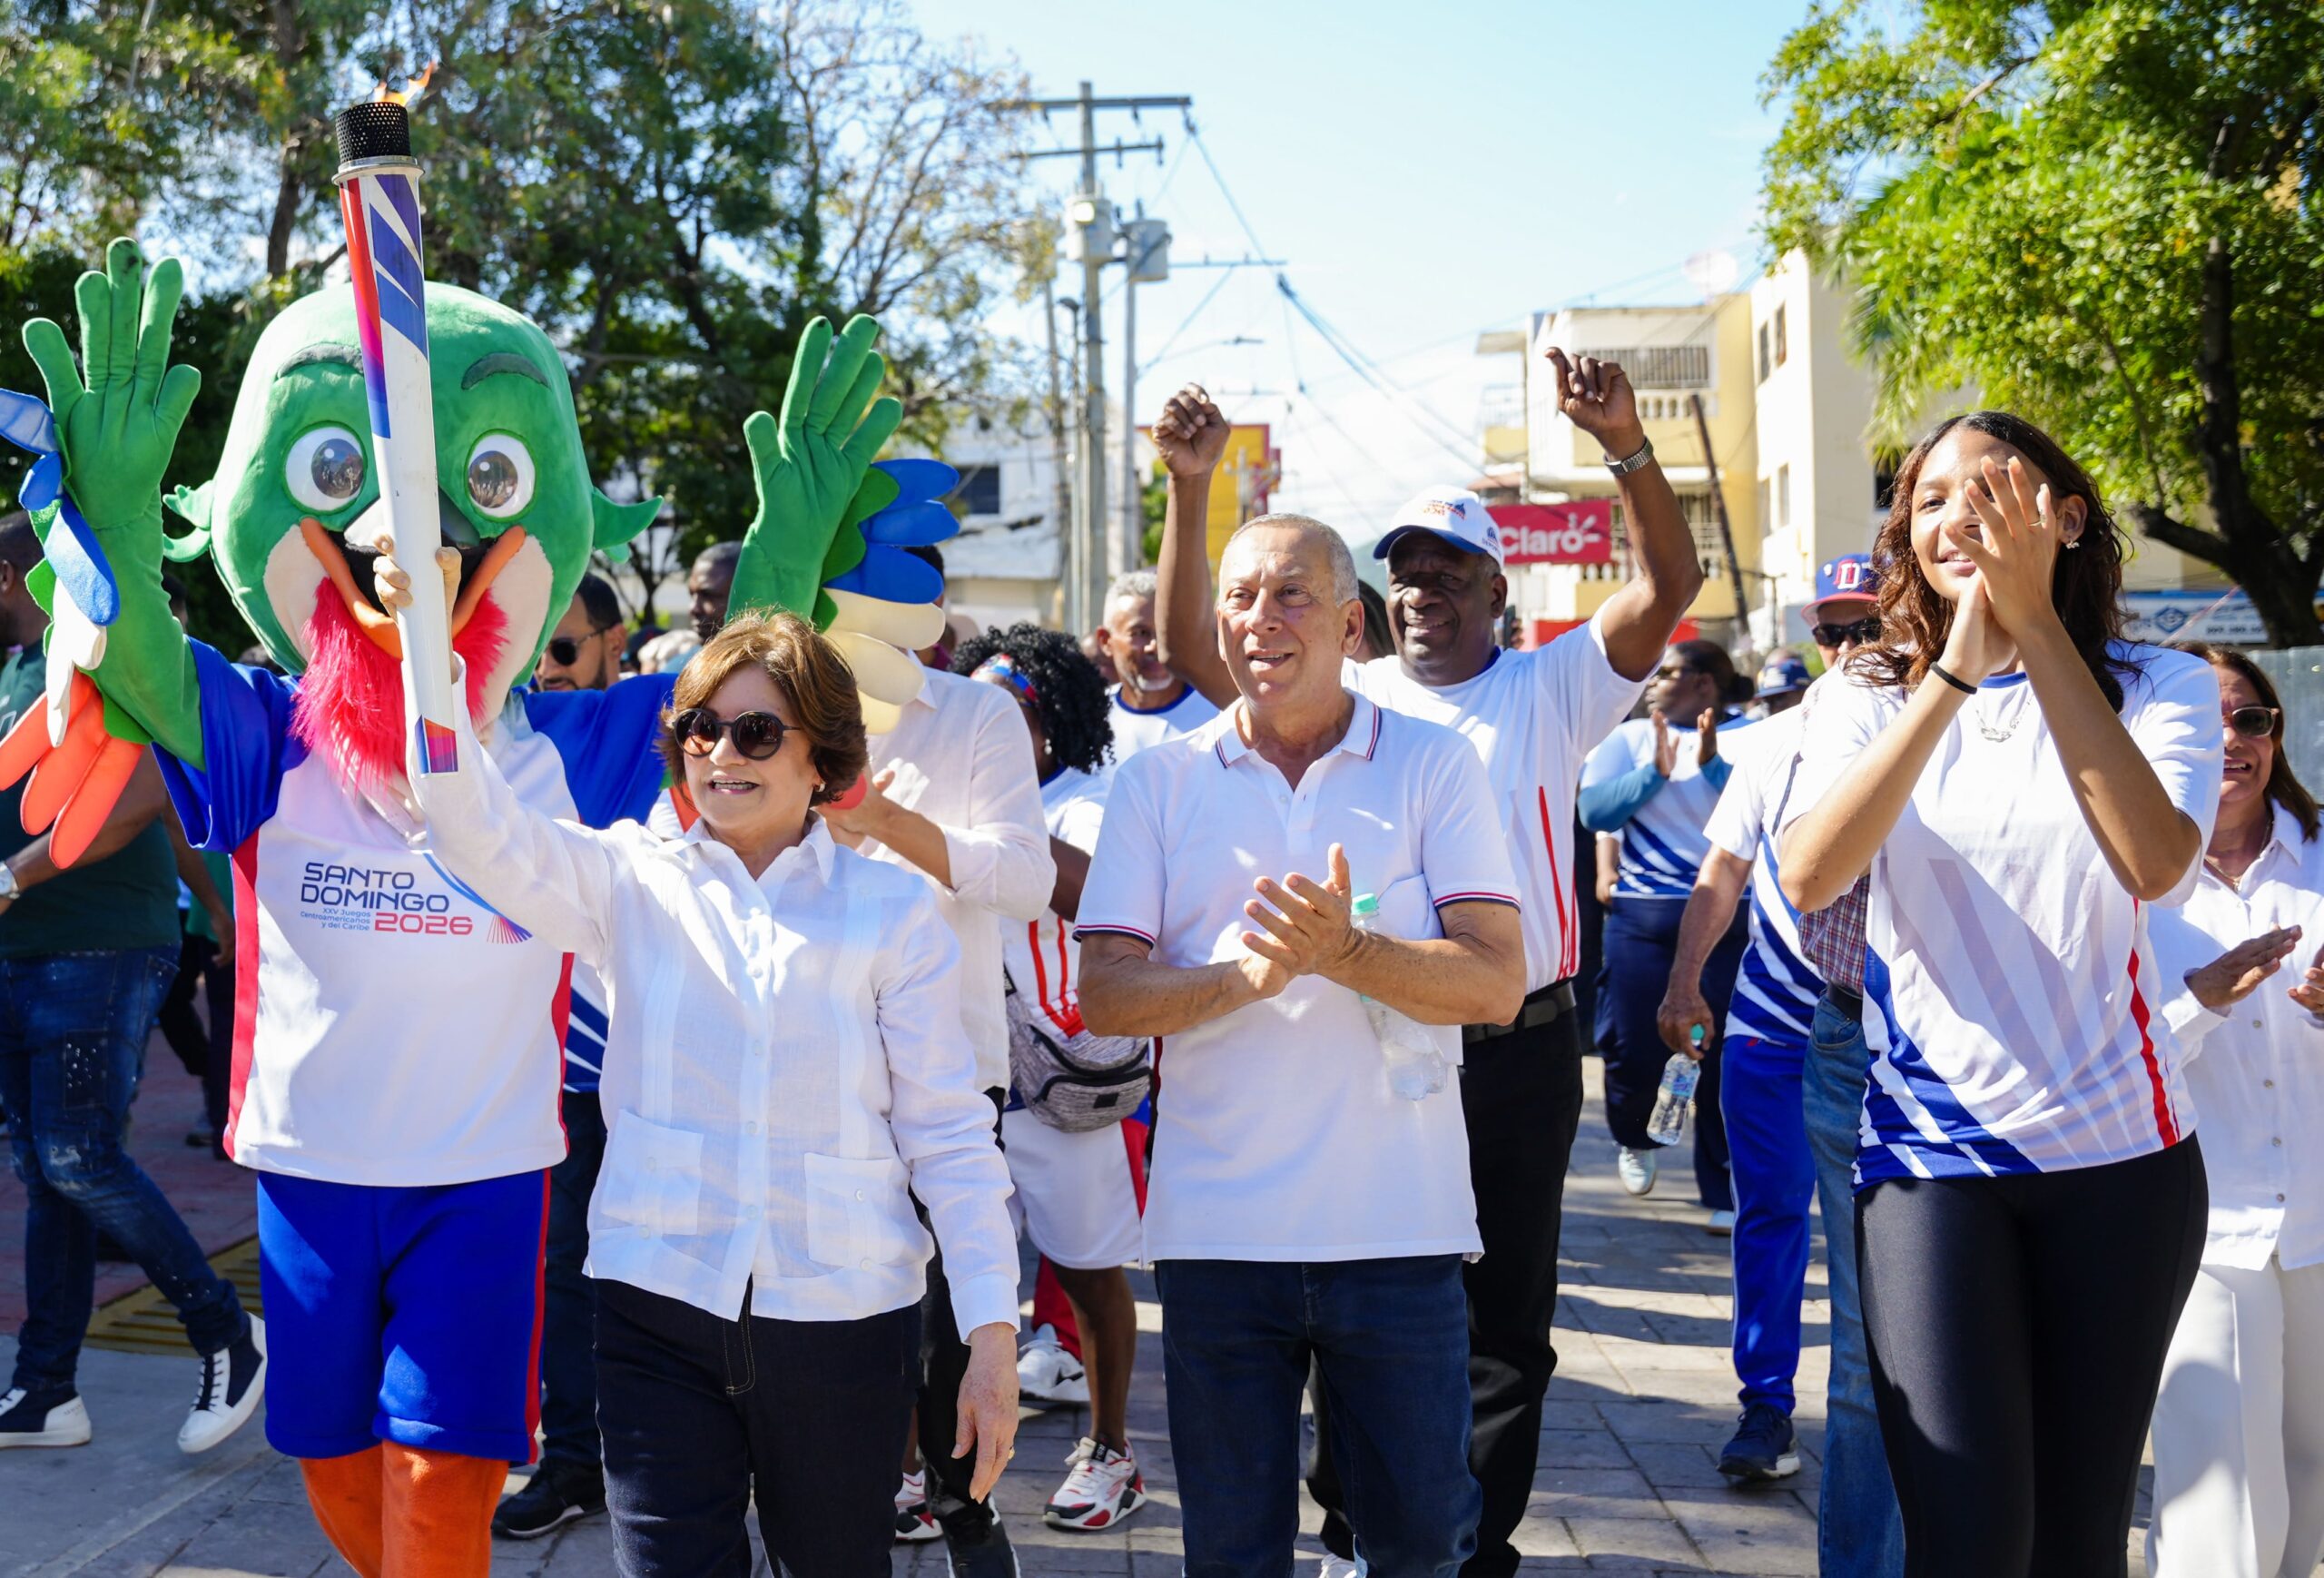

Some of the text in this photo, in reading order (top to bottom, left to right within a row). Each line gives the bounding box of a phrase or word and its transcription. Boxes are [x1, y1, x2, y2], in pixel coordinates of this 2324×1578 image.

[1500, 525, 1584, 556] Claro
[304, 862, 415, 890] SANTO
[300, 883, 449, 912] DOMINGO
[300, 912, 370, 924] Centroamericanos
[340, 910, 371, 918] Juegos
[375, 912, 473, 935] 2026
[342, 922, 370, 931] Caribe
